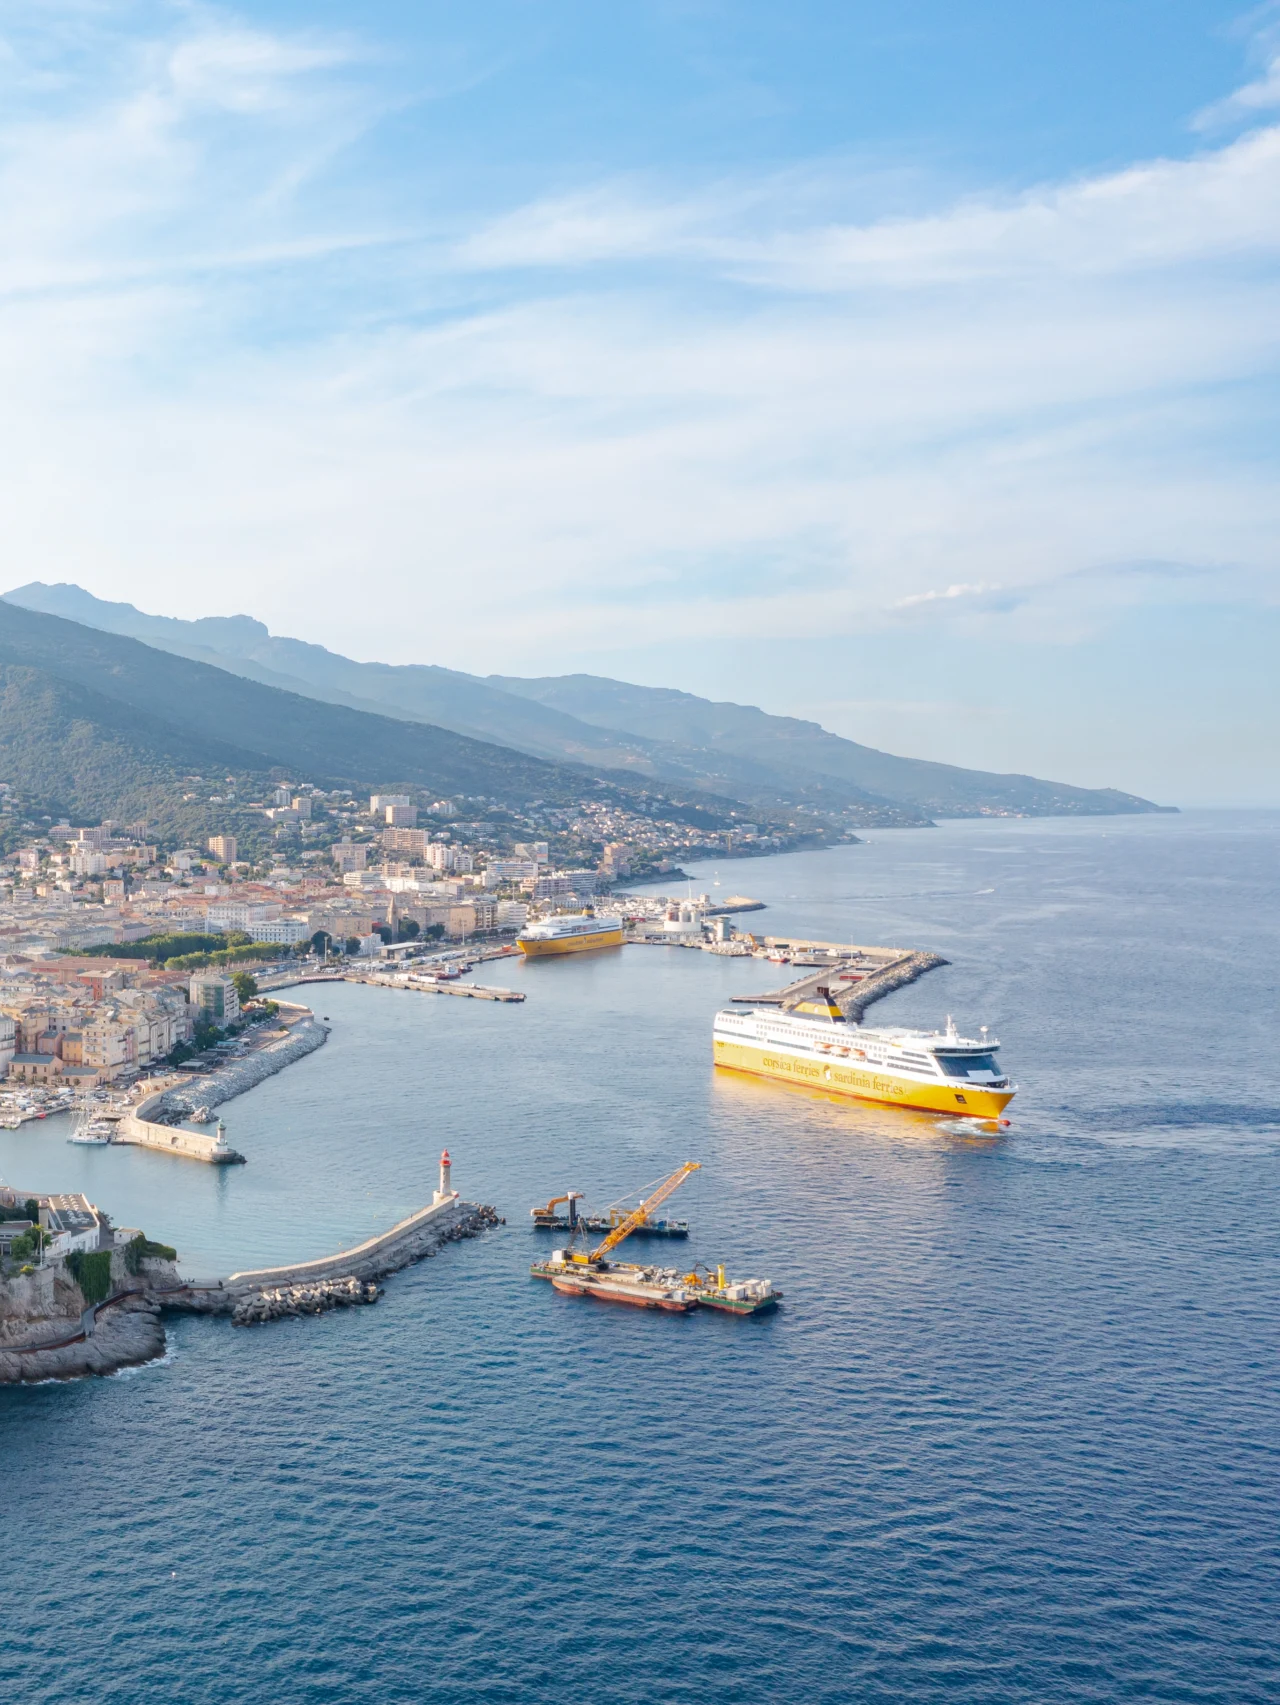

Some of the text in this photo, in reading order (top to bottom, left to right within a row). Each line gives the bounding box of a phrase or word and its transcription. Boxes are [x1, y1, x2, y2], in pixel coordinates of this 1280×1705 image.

[763, 1057, 820, 1078] corsica ferries
[834, 1070, 904, 1096] sardinia ferries
